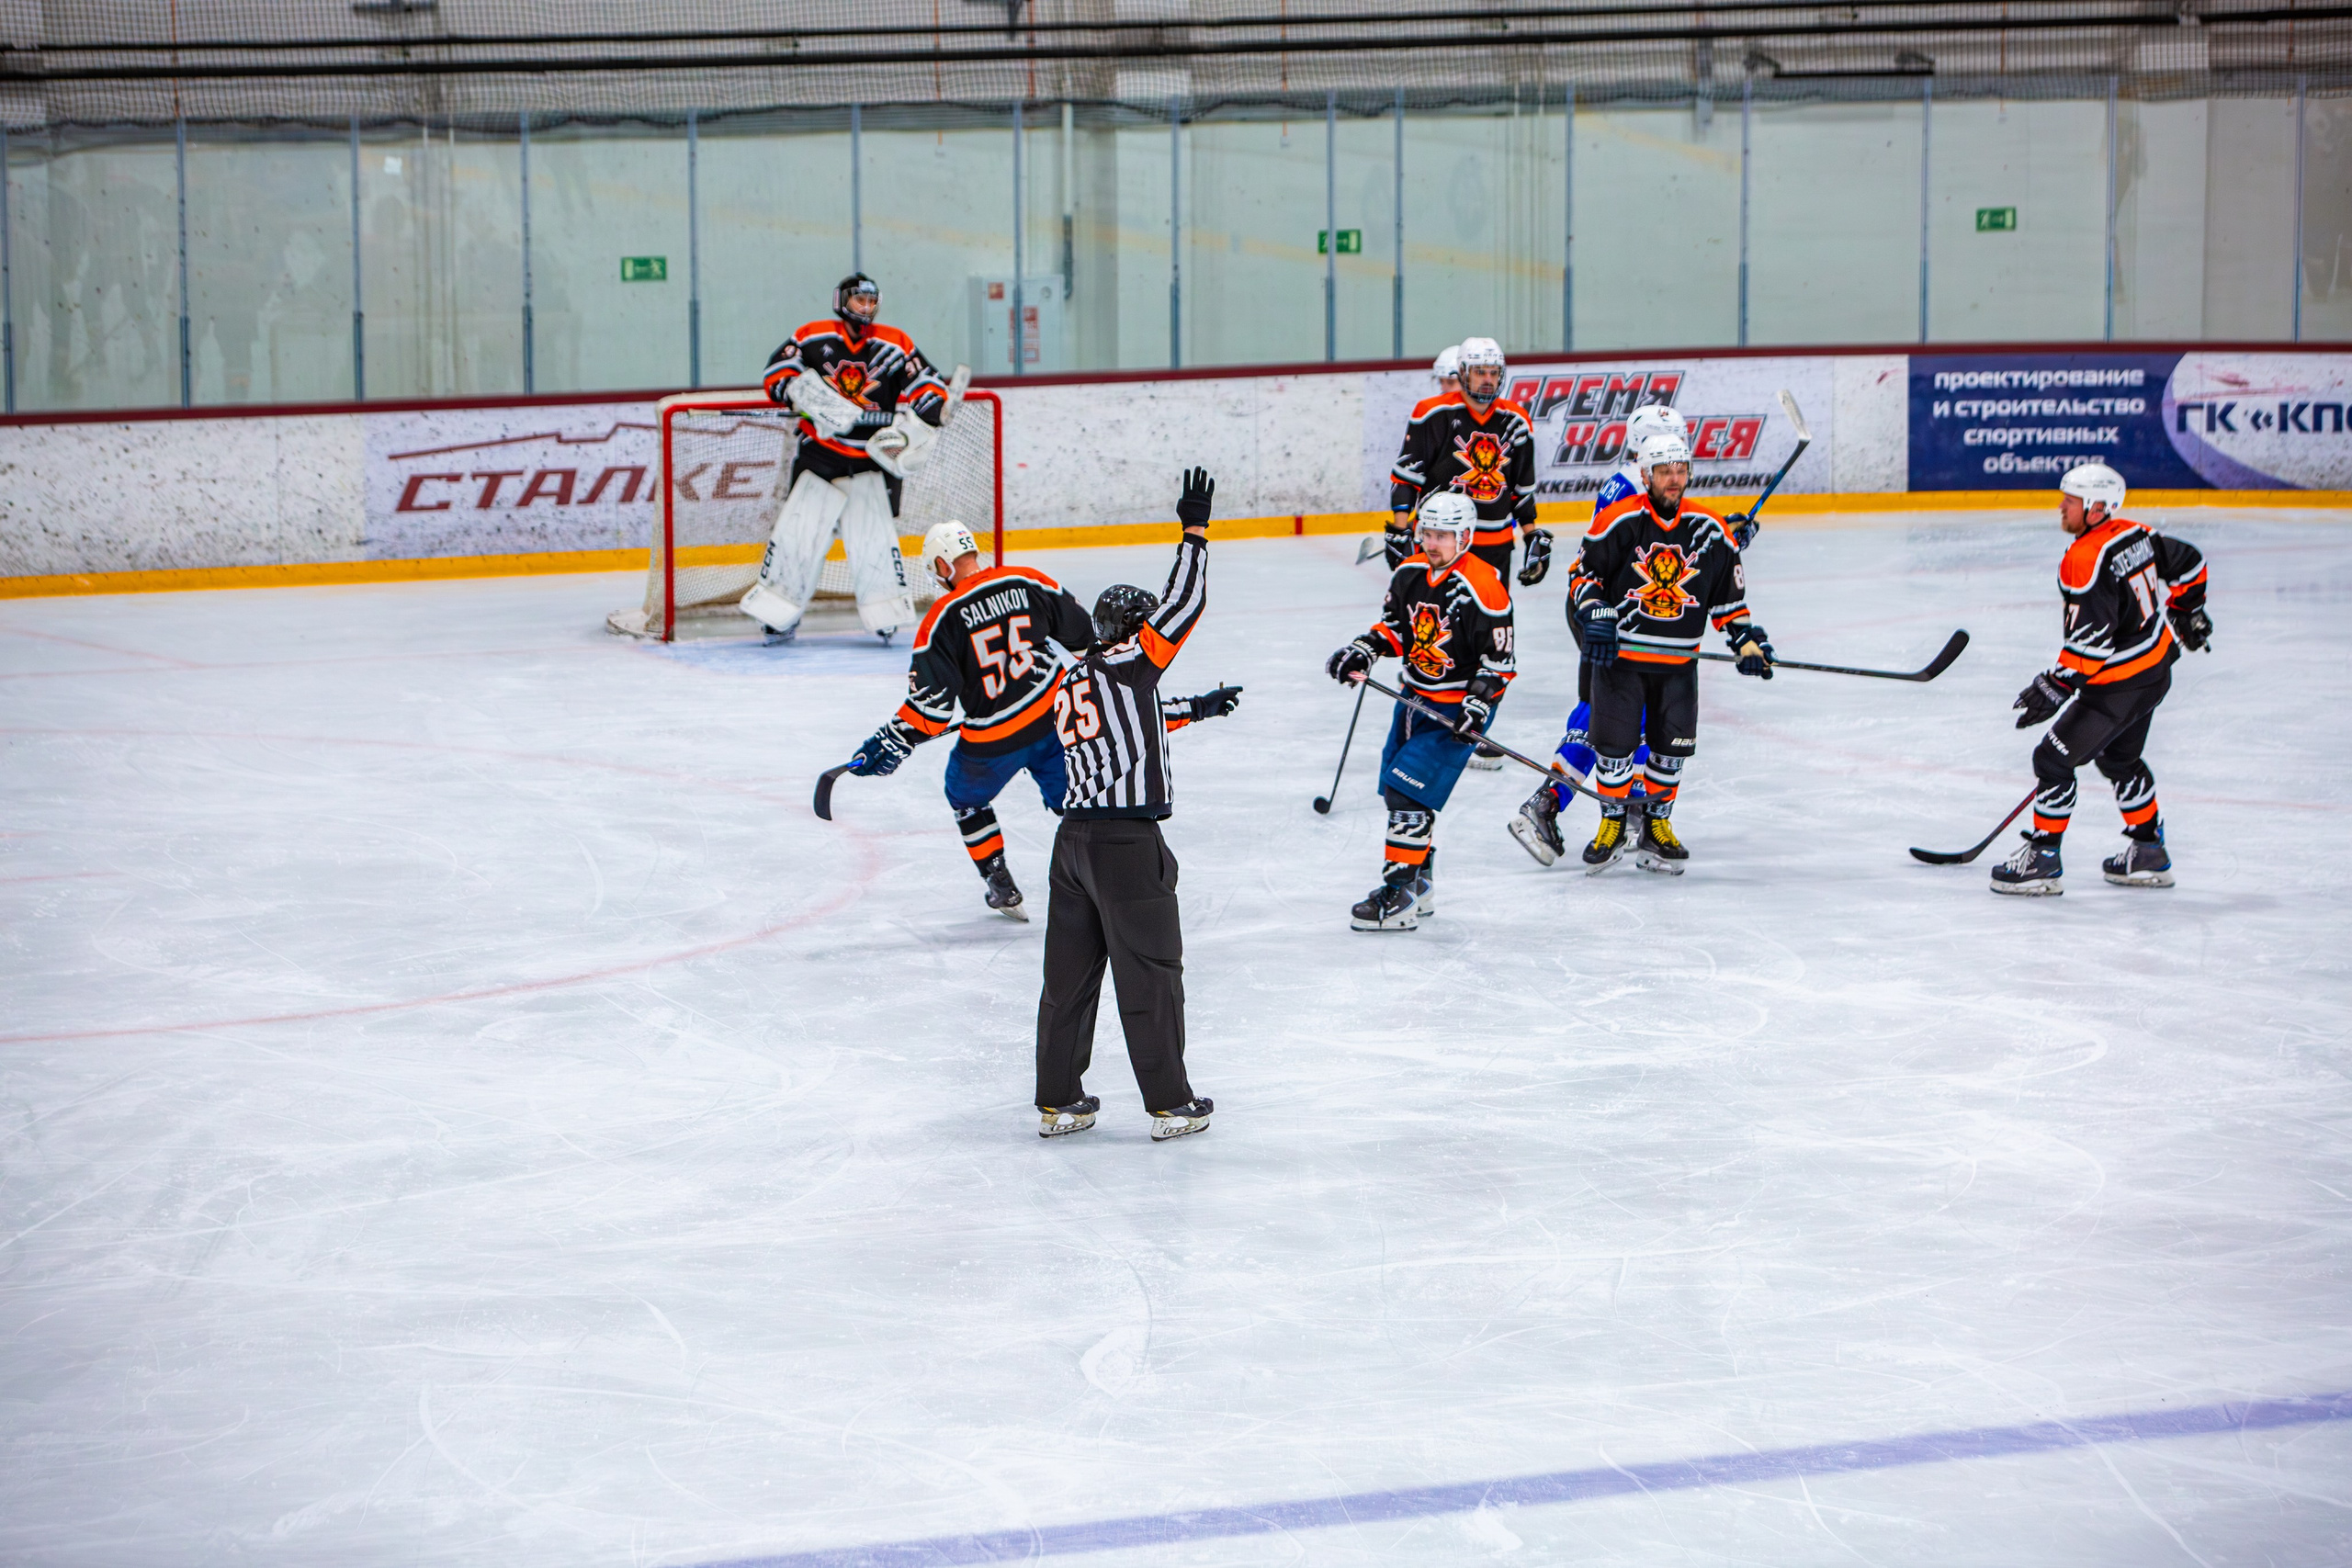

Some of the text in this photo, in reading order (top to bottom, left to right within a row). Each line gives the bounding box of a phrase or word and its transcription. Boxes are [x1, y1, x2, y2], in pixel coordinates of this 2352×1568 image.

[1506, 370, 1685, 422] ВРЕМЯ
[1934, 367, 2145, 393] проектирование
[1933, 397, 2146, 421] и строительство
[2176, 401, 2239, 434] ГК
[1552, 413, 1768, 467] ХОЕЯ
[1962, 425, 2120, 448] спортивных
[395, 460, 781, 513] СТАЛКЕ
[1534, 474, 1604, 494] ККЕЙН
[760, 539, 776, 580] CCM
[958, 536, 974, 550] 55
[891, 546, 907, 587] CCM
[959, 588, 1030, 629] SALNIKOV
[1492, 626, 1514, 652] 86
[969, 615, 1035, 701] 55
[1054, 679, 1101, 748] 25
[1670, 737, 1697, 748] BAU
[1391, 767, 1426, 790] BAUER
